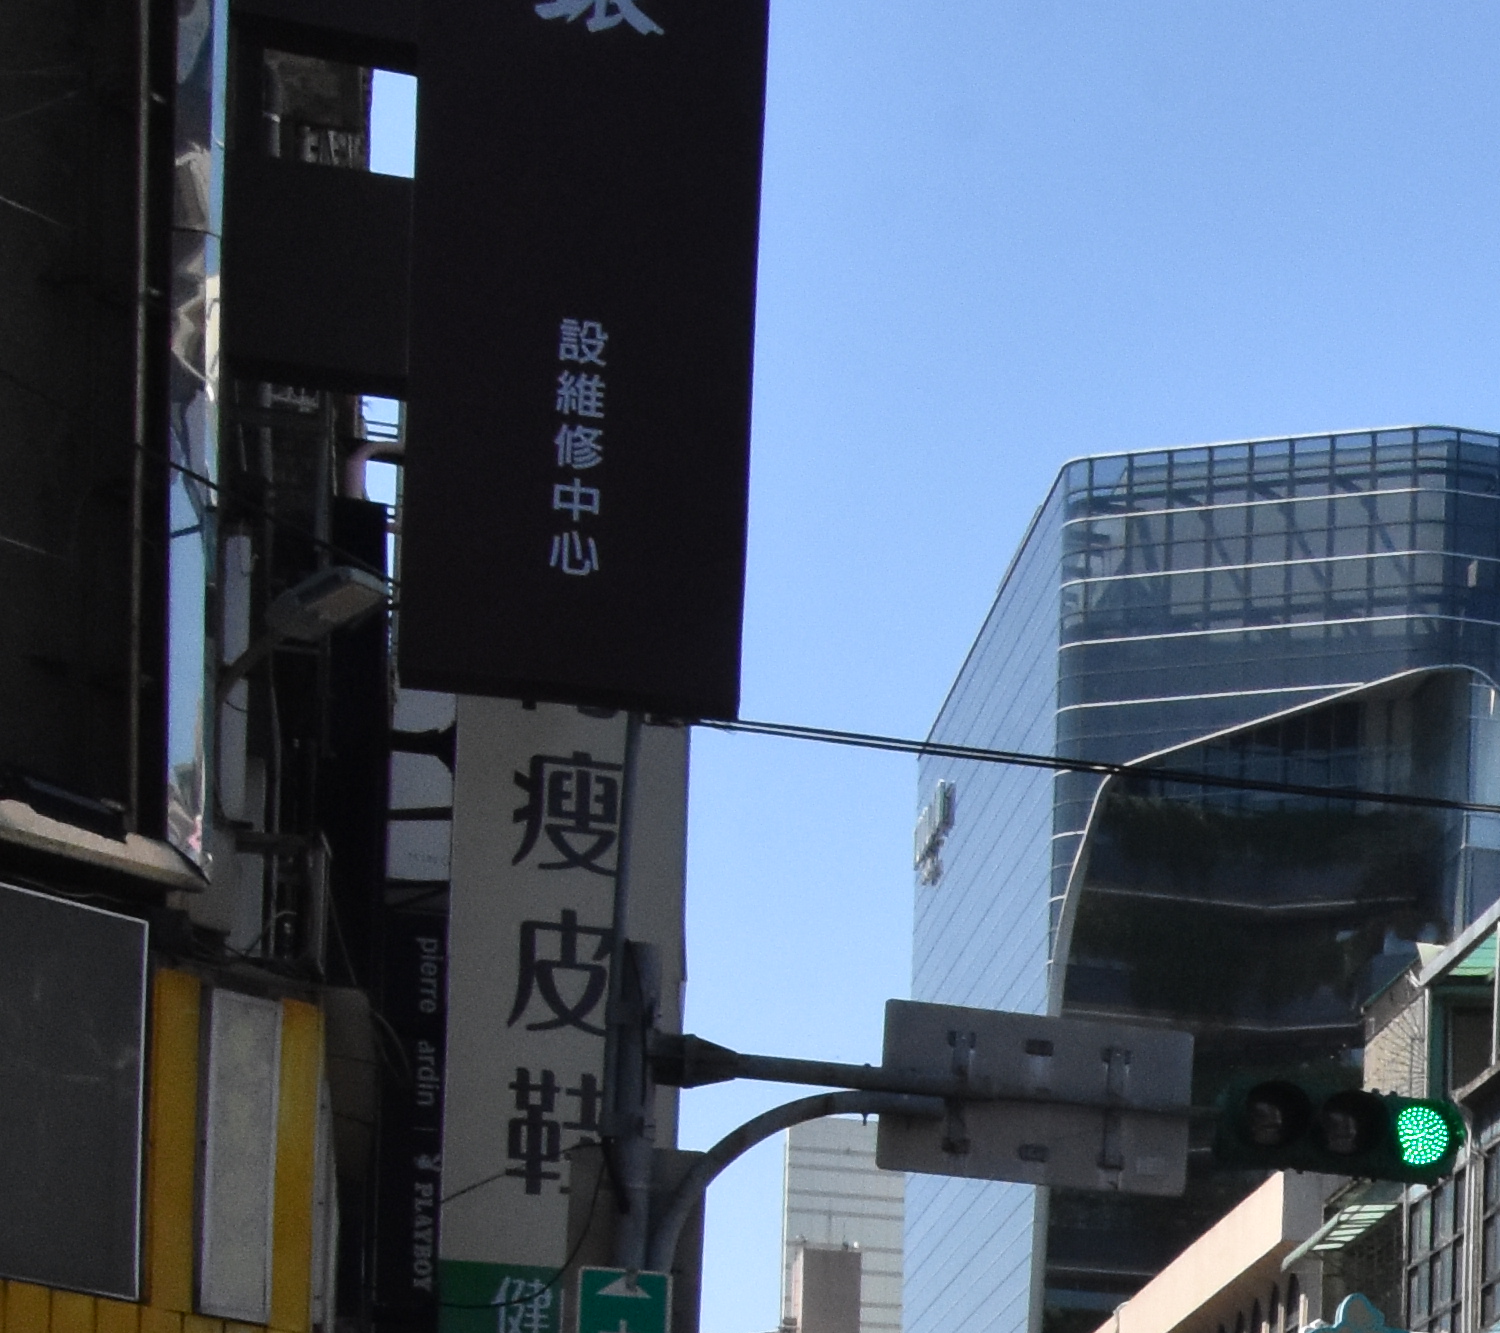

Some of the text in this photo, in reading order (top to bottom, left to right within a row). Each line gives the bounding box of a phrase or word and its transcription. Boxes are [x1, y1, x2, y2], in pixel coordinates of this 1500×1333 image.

[548, 318, 607, 578] 設維修中心
[414, 936, 439, 1014] pierre
[507, 697, 624, 1195] 瘦皮鞋
[411, 1183, 434, 1294] PLAYBOY
